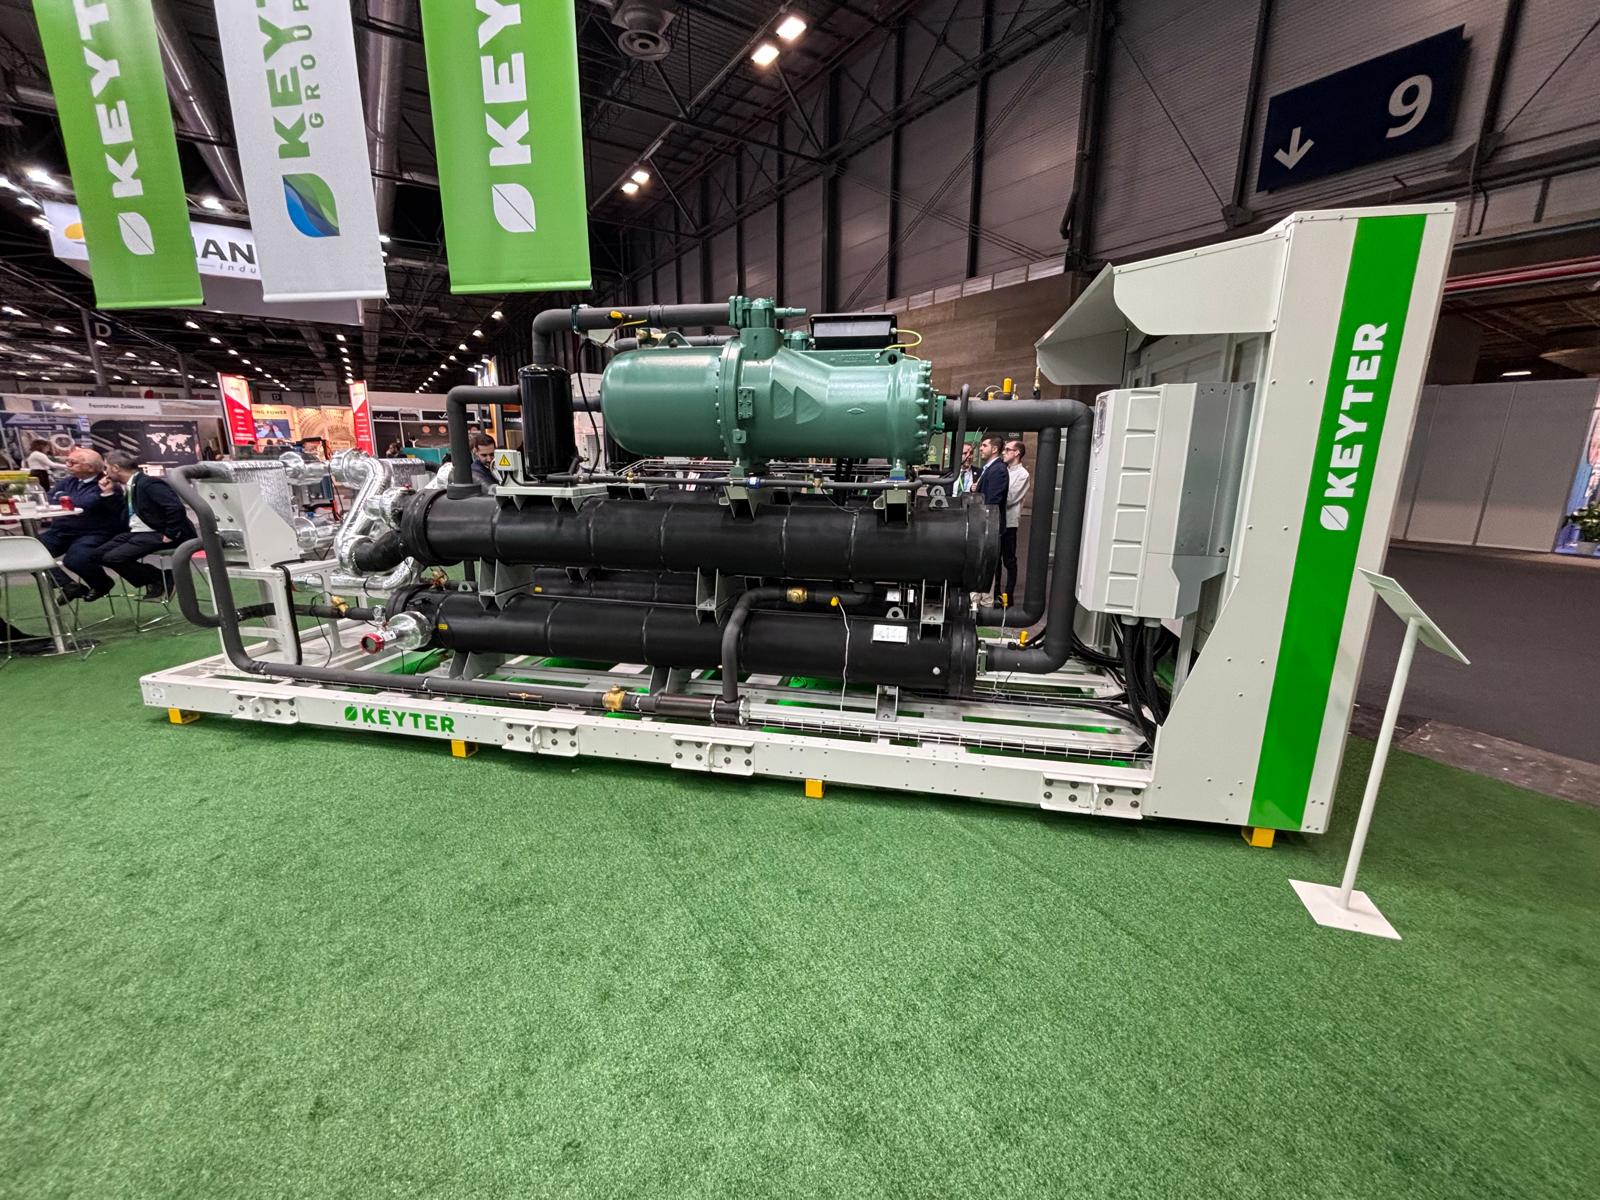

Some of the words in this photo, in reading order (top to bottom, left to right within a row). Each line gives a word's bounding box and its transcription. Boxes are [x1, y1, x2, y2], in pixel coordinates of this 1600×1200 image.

[256, 0, 311, 159] KEY
[1385, 74, 1433, 139] 9
[191, 237, 257, 265] AN
[94, 321, 113, 338] D
[1323, 322, 1389, 498] KEYTER
[361, 707, 456, 734] KEYTER
